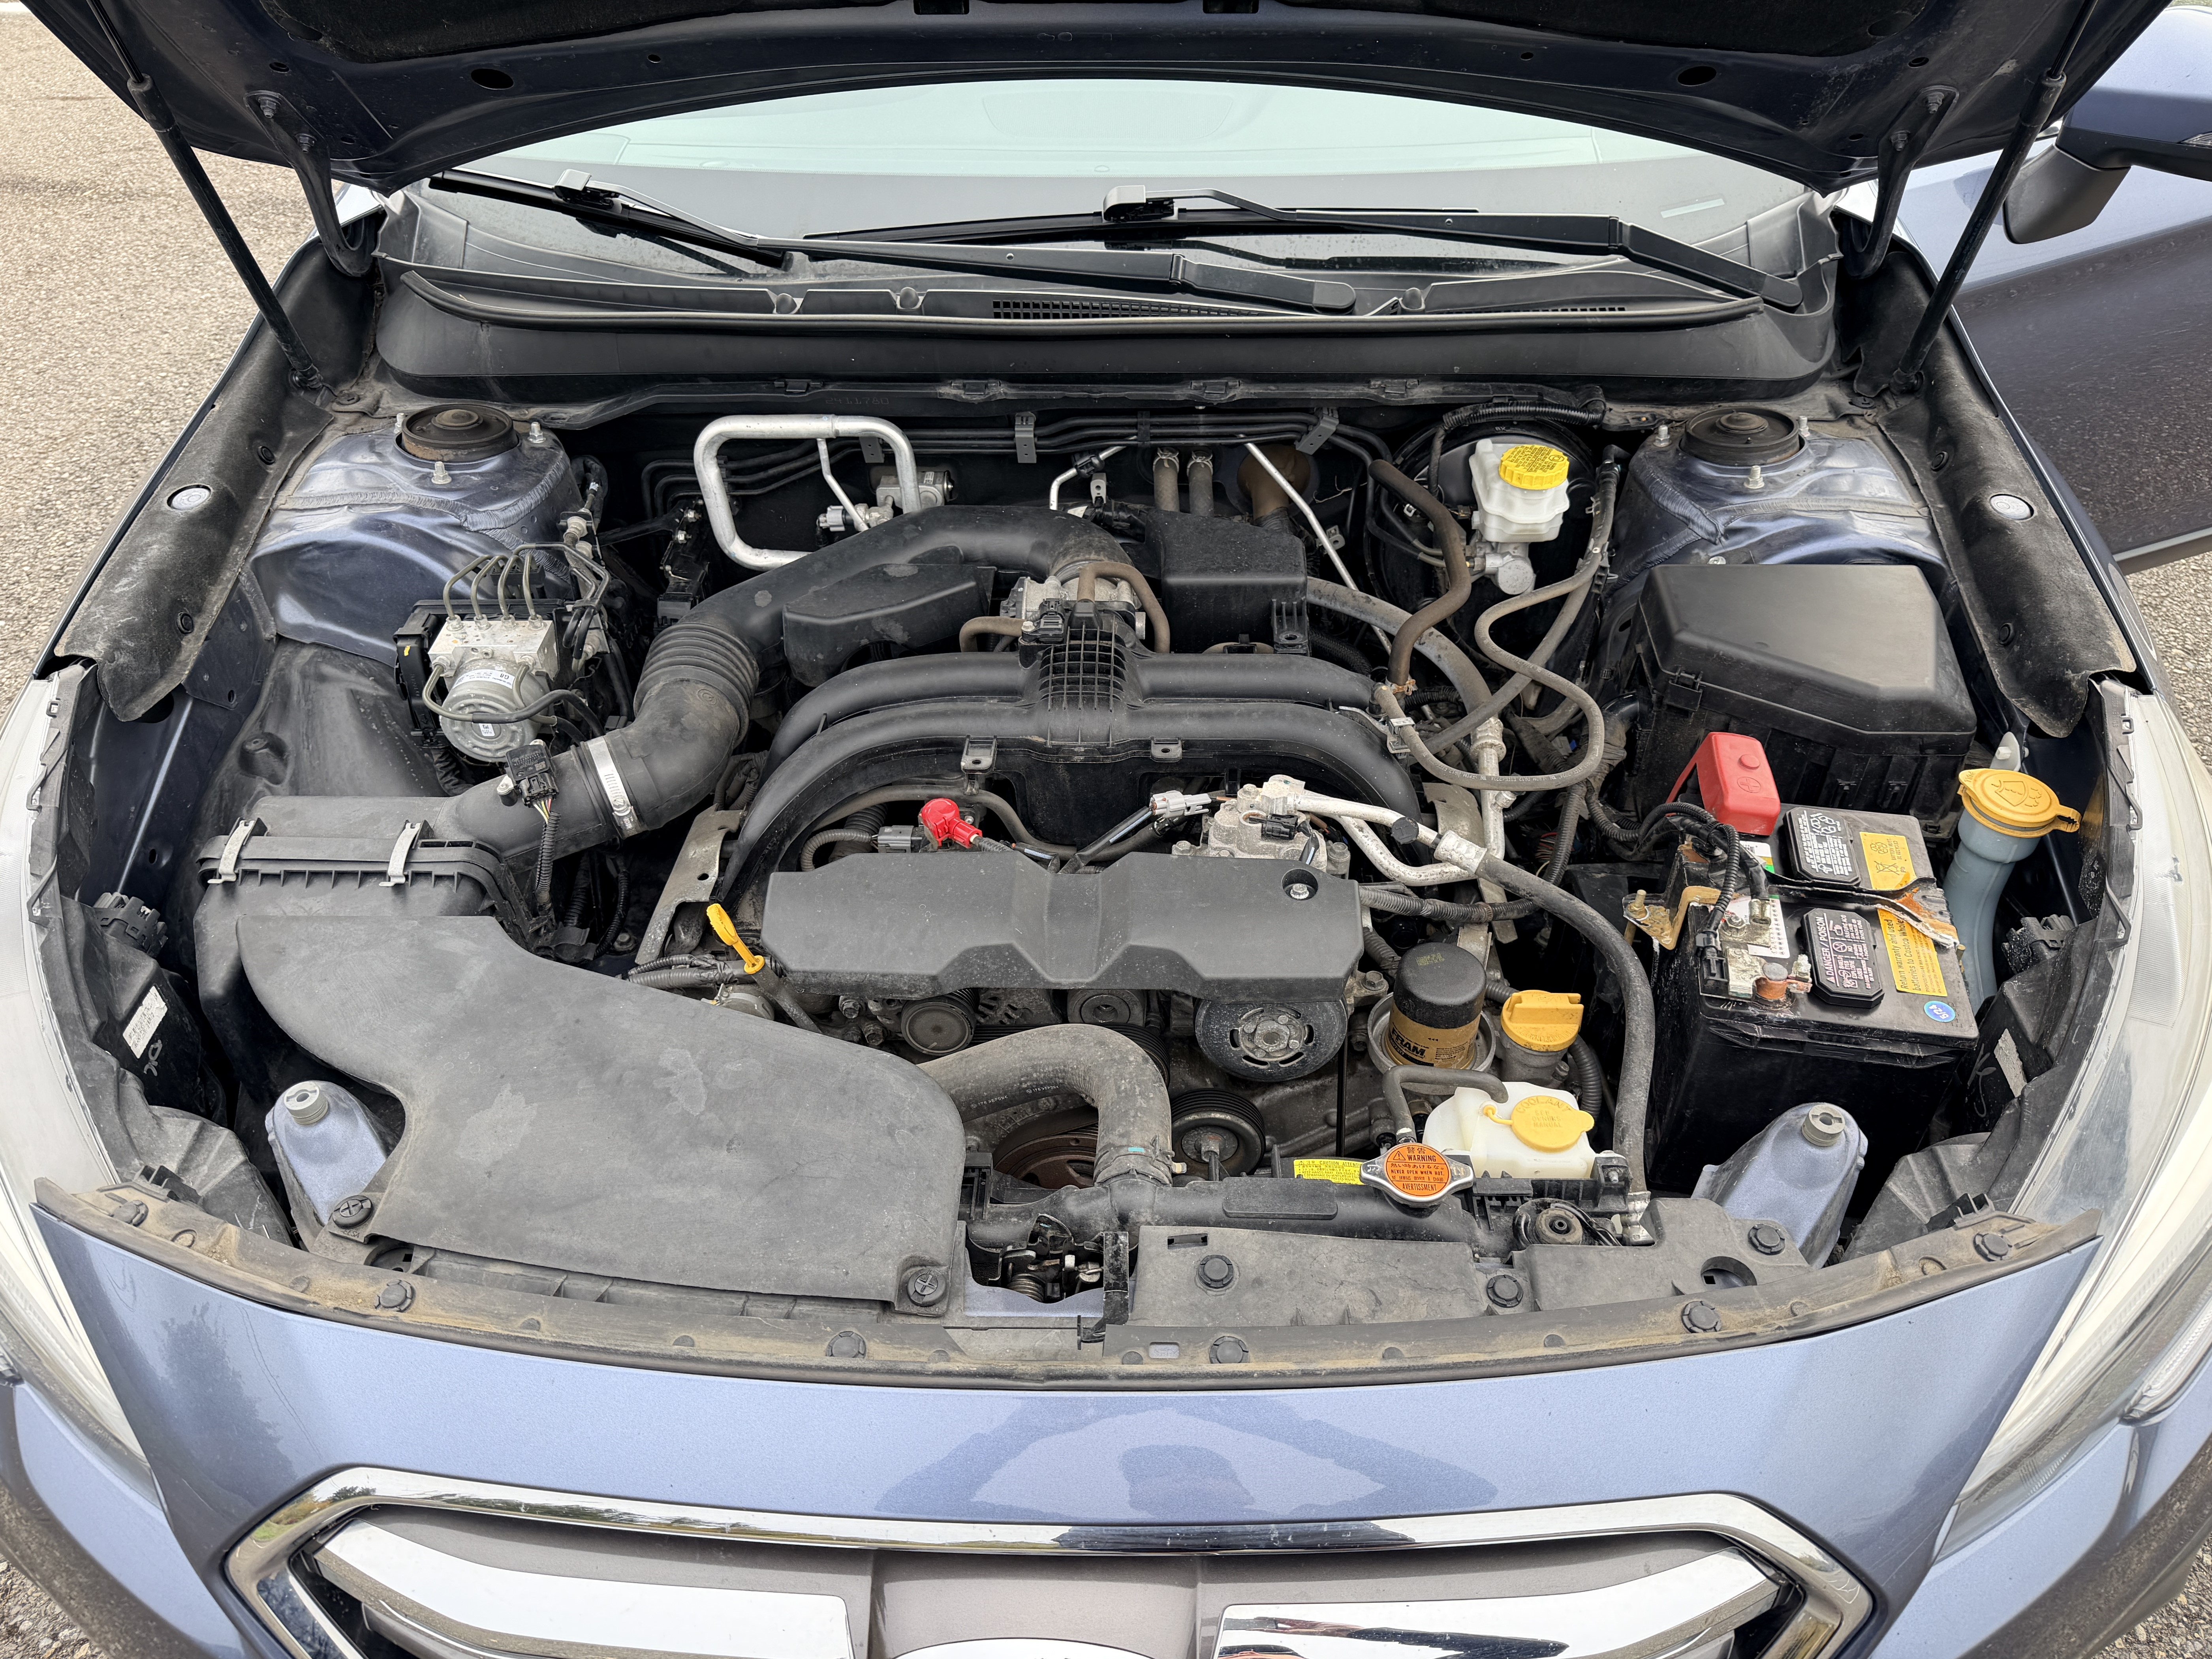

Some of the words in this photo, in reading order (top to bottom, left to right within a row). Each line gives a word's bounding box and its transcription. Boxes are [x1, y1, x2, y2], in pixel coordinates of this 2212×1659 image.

[1816, 917, 1827, 941] POISON
[1886, 919, 1894, 932] used
[1887, 933, 1897, 944] and
[1903, 938, 1912, 957] Costco
[1821, 948, 1834, 976] DANGER
[1893, 946, 1903, 969] warranty
[1898, 970, 1908, 989] Return
[1909, 965, 1921, 990] batteries
[1392, 1027, 1425, 1056] FRAM
[1517, 1097, 1571, 1113] COOLANT
[1402, 1183, 1437, 1191] AVERTISSMENT
